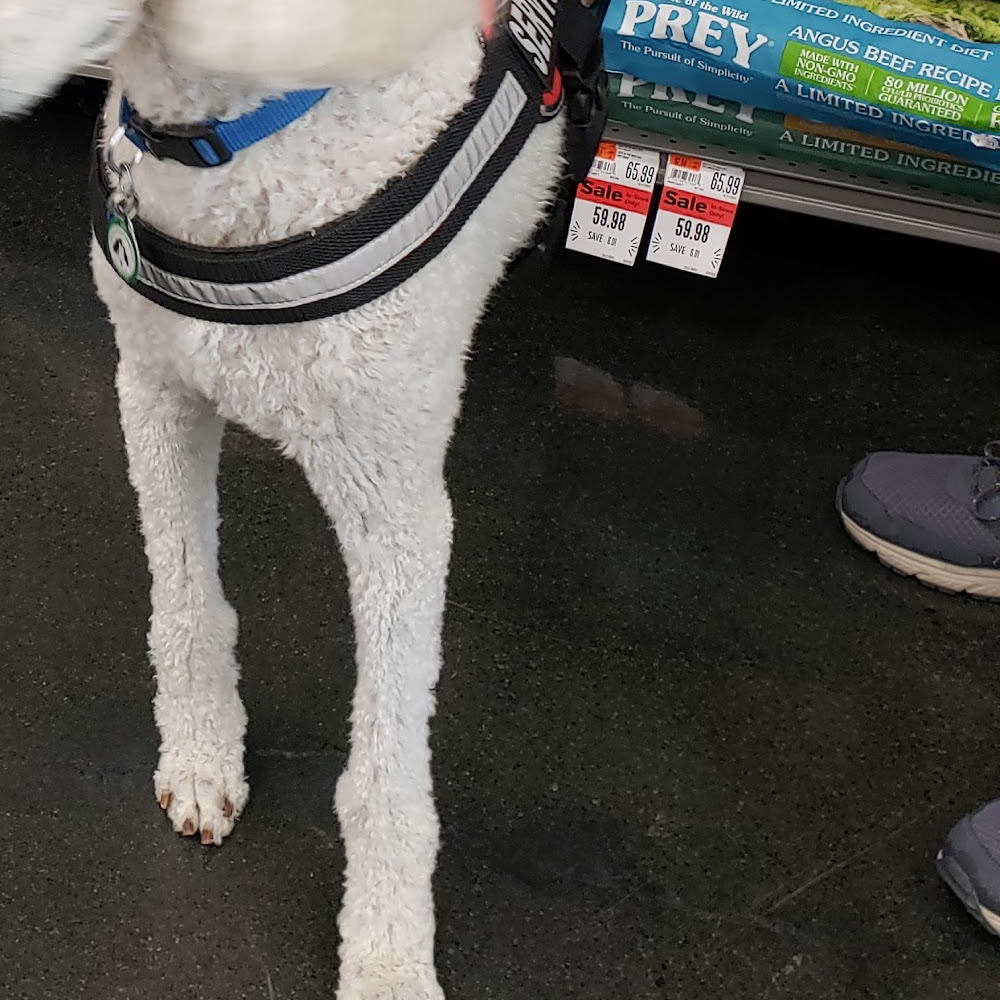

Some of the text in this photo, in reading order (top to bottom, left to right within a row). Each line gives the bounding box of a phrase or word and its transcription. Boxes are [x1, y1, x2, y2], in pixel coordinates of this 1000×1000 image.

[699, 1, 719, 14] the
[722, 6, 749, 21] Wild
[616, 0, 768, 69] PREY
[841, 14, 948, 48] INGREDIENT
[950, 43, 994, 62] DIET
[620, 40, 750, 84] The Pursuit of Simplicity
[788, 25, 993, 98] ANGUS BEEF RECIPE
[799, 49, 830, 65] MADE
[796, 59, 857, 83] NON-GMO
[797, 84, 884, 119] LIMITED
[883, 75, 969, 107] 80 MILLION
[621, 101, 697, 124] The of
[878, 92, 962, 122] GUARANTEED
[779, 130, 891, 162] A LIMITED
[625, 162, 655, 184] 65.99
[710, 172, 741, 196] 65.99
[580, 180, 623, 202] Sale
[664, 191, 708, 213] Sale
[592, 207, 627, 231] 59.98
[675, 218, 710, 243] 59.98
[588, 231, 603, 243] SAVE
[670, 243, 686, 255] SAVE
